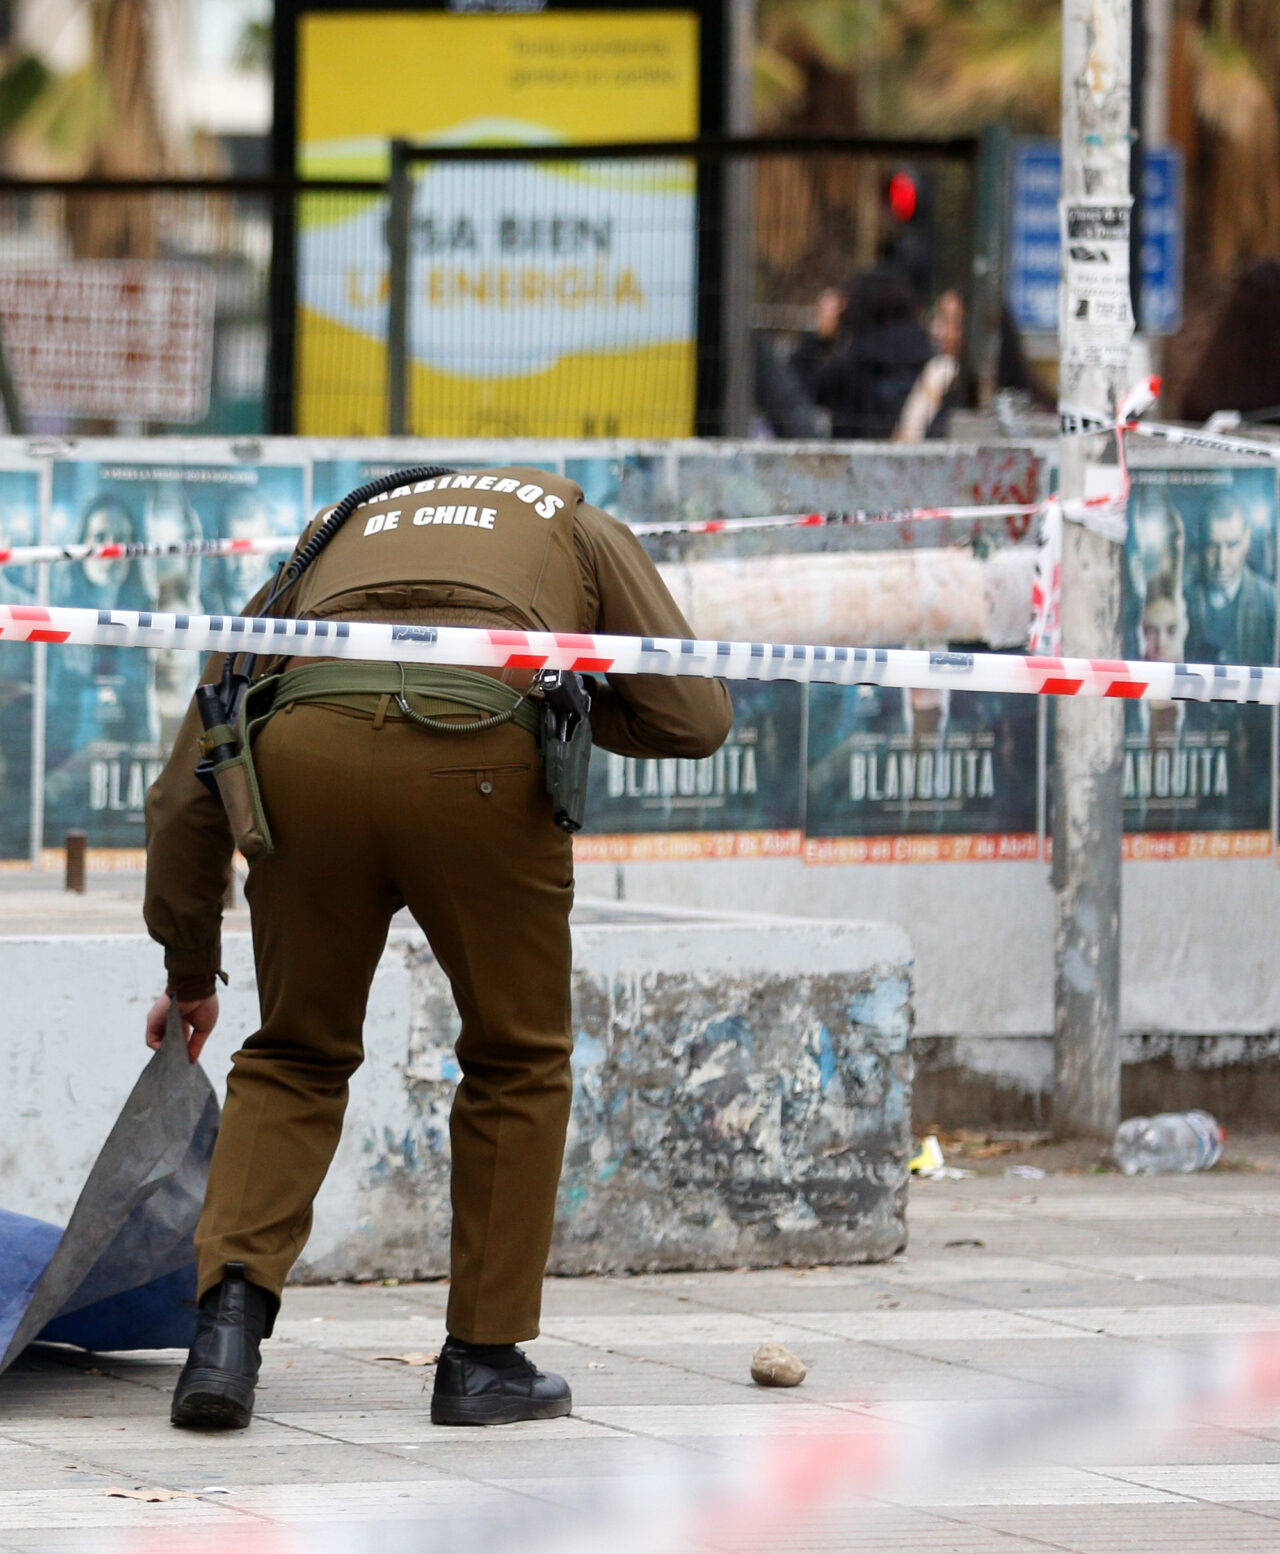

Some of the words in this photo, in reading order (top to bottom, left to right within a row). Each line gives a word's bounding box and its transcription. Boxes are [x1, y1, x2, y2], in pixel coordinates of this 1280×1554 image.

[499, 210, 613, 257] BIEN
[323, 475, 566, 524] ABINEROS
[363, 510, 402, 537] DE
[412, 505, 498, 530] CHILE
[607, 746, 758, 798] BLANQUITA
[849, 750, 995, 801] BLANQUITA
